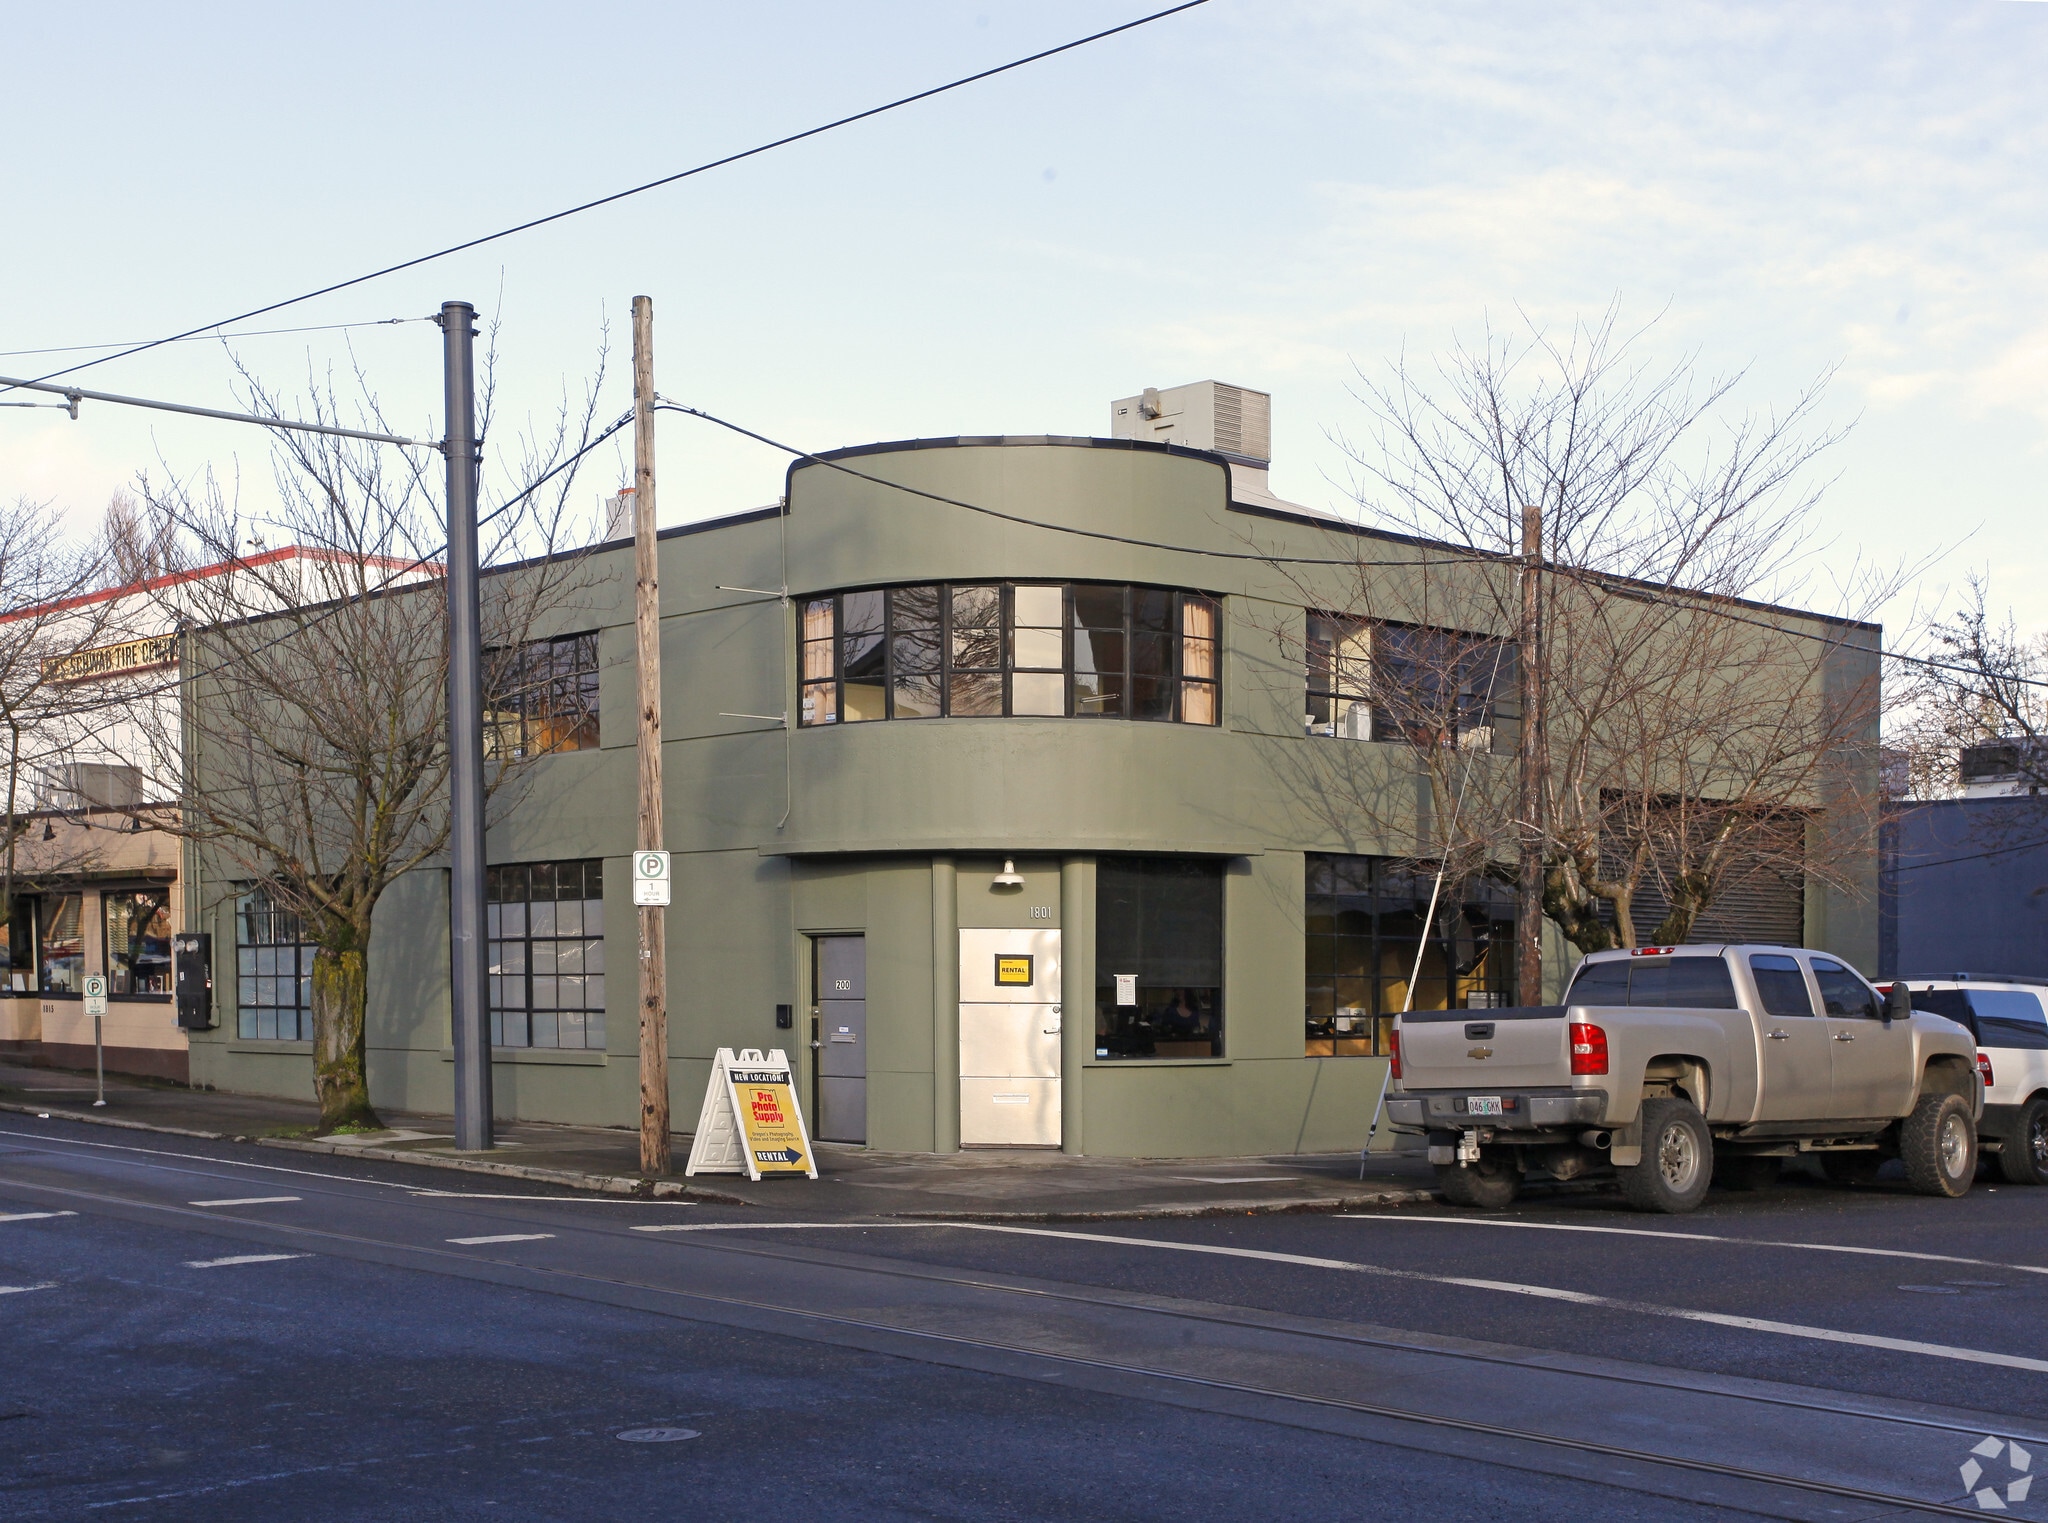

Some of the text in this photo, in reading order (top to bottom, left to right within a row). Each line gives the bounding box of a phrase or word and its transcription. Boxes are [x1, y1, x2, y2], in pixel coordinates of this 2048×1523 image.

[115, 645, 137, 667] TIRE
[646, 859, 658, 873] P
[649, 882, 654, 891] 1
[1030, 906, 1051, 919] 1801
[91, 983, 99, 992] P
[836, 980, 850, 990] 200
[734, 1073, 784, 1082] NEW LOCATION!
[757, 1092, 773, 1102] Pro
[751, 1101, 778, 1111] Photo
[1470, 1101, 1483, 1112] 046
[753, 1111, 784, 1123] Supply
[756, 1151, 789, 1162] RENTAL
